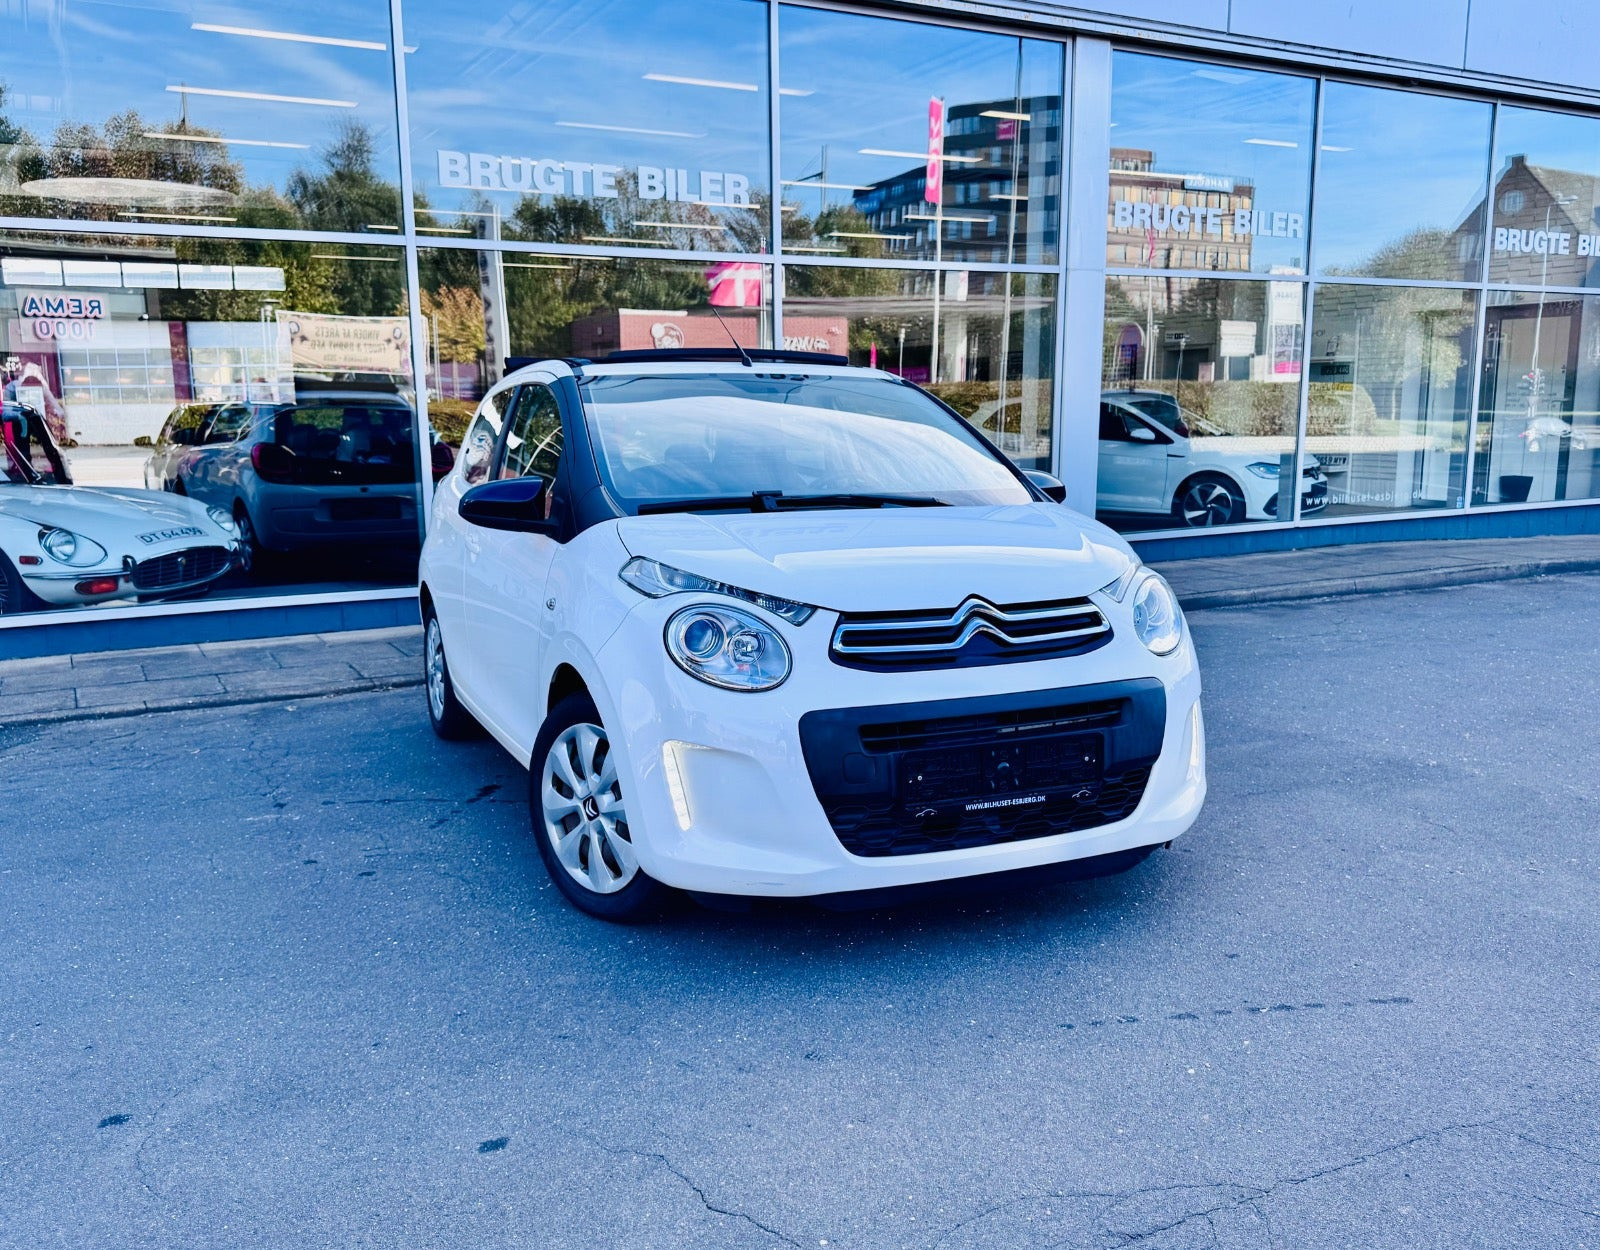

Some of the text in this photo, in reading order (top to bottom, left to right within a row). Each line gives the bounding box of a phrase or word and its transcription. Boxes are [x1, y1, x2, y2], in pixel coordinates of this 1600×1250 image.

[437, 149, 750, 206] BRUGTE BILER
[1114, 200, 1303, 239] BRUGTE BILER
[1494, 227, 1571, 256] BRUGTE
[140, 533, 160, 543] DT
[965, 795, 1046, 811] WWW.BILHUSET-ESBJERG.DK
